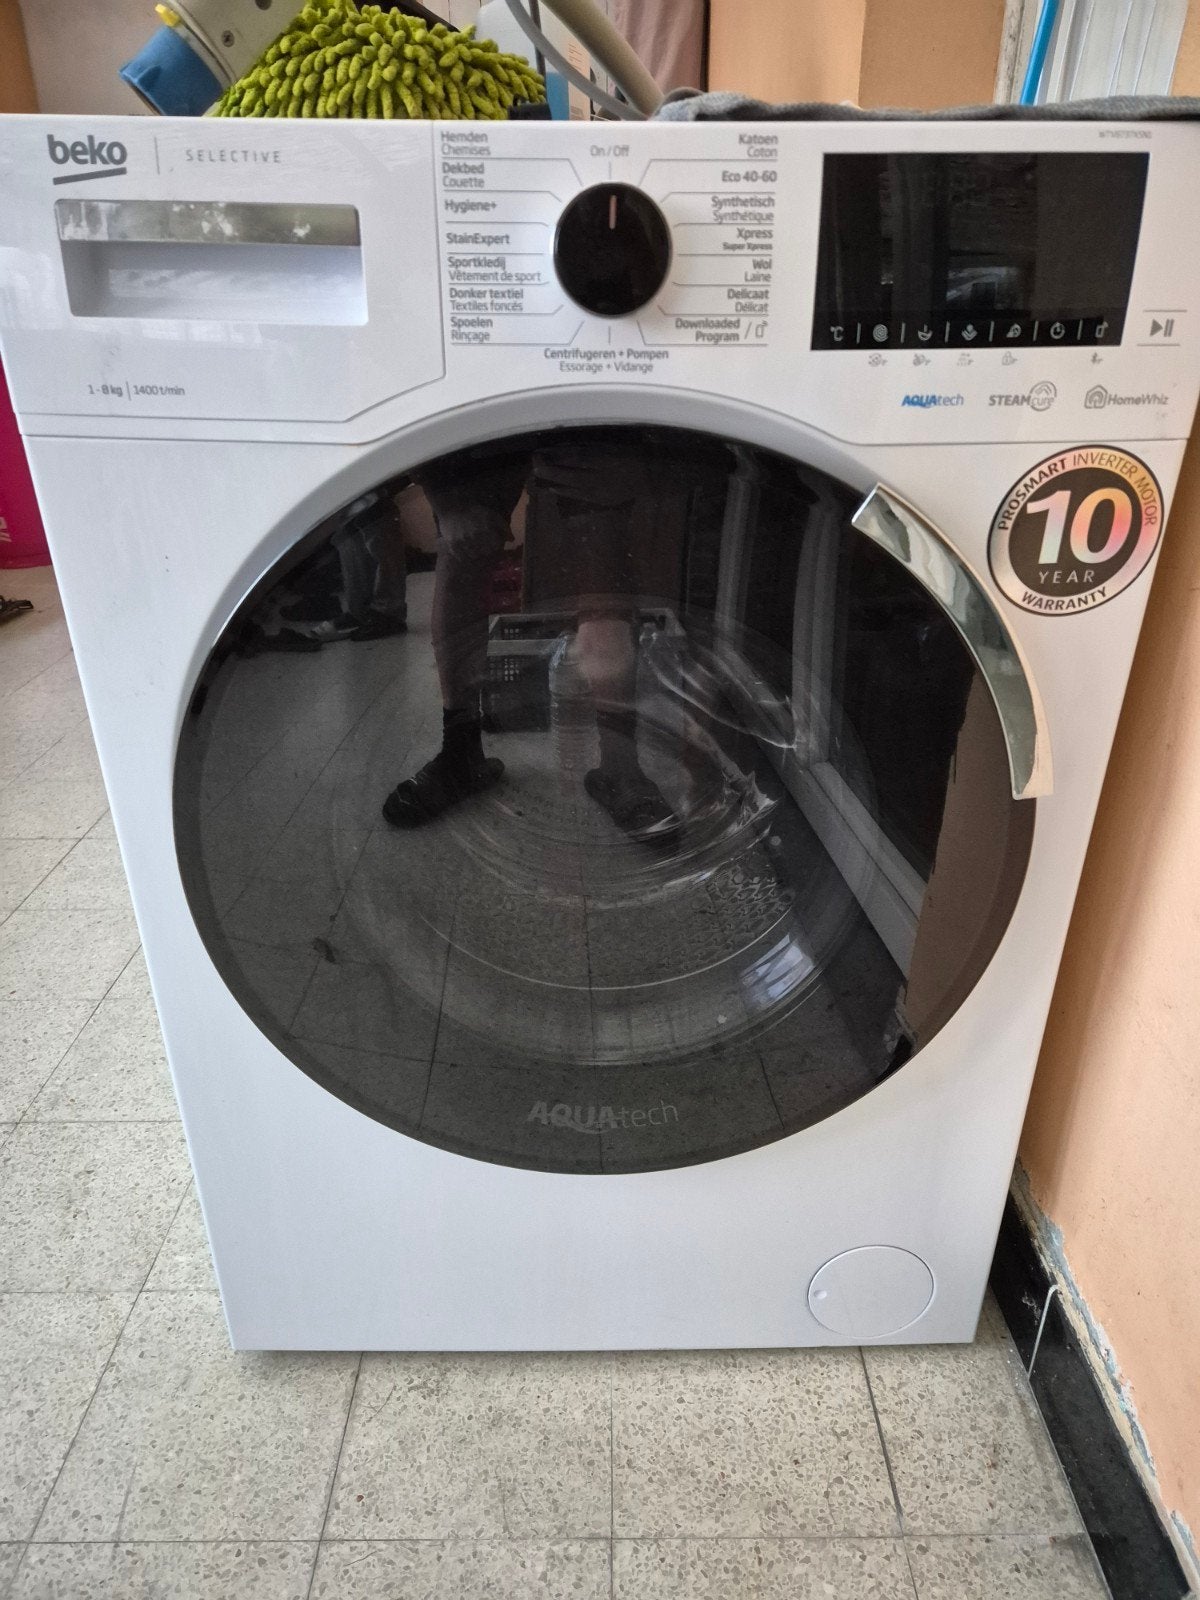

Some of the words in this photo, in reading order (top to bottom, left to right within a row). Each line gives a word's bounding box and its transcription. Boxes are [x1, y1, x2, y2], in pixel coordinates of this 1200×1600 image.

[441, 131, 488, 143] Hemden
[738, 134, 778, 145] Katoen
[47, 134, 127, 165] beko
[442, 145, 491, 155] Chemises
[590, 144, 606, 157] On
[613, 144, 630, 157] Off
[747, 147, 778, 158] Coton
[185, 149, 281, 163] SELECTIVE
[442, 162, 484, 174] Dekbed
[722, 171, 741, 182] Eco
[743, 170, 777, 182] 40-60
[443, 177, 484, 188] Couette
[445, 201, 496, 213] Hygiene+
[711, 196, 775, 210] Synthetisch
[446, 233, 510, 246] StainExpert
[737, 228, 773, 240] Xpress
[723, 242, 745, 252] Super
[747, 242, 773, 251] Xpress
[448, 257, 506, 270] Sportkledij
[753, 259, 772, 270] Wol
[449, 271, 499, 282] Vêtement
[503, 271, 513, 281] de
[515, 273, 541, 284] sport
[744, 272, 772, 282] Laine
[450, 289, 487, 299] Donker
[490, 288, 524, 299] textiel
[727, 289, 769, 300] Delicaat
[451, 302, 488, 312] Textiles
[490, 301, 523, 312] foncés
[451, 317, 493, 330] Spoelen
[675, 318, 740, 329] Downloaded
[451, 330, 490, 343] Rinçage
[696, 332, 739, 344] Program
[544, 348, 616, 361] Centrifugeren
[627, 348, 669, 361] Pompen
[560, 361, 603, 374] Essorage
[614, 362, 653, 374] Vidange
[110, 384, 123, 397] kg
[133, 385, 158, 395] 1400
[901, 393, 964, 408] AQUAtech
[1107, 394, 1169, 406] HomeWhiz
[998, 458, 1066, 531] PROSMART
[1073, 452, 1138, 477] INVERTER
[1133, 476, 1158, 526] MOTOR
[1026, 487, 1133, 565] 10
[1038, 569, 1095, 584] YEAR
[1021, 586, 1107, 611] WARRANTY
[527, 1100, 679, 1134] AQUAtech
